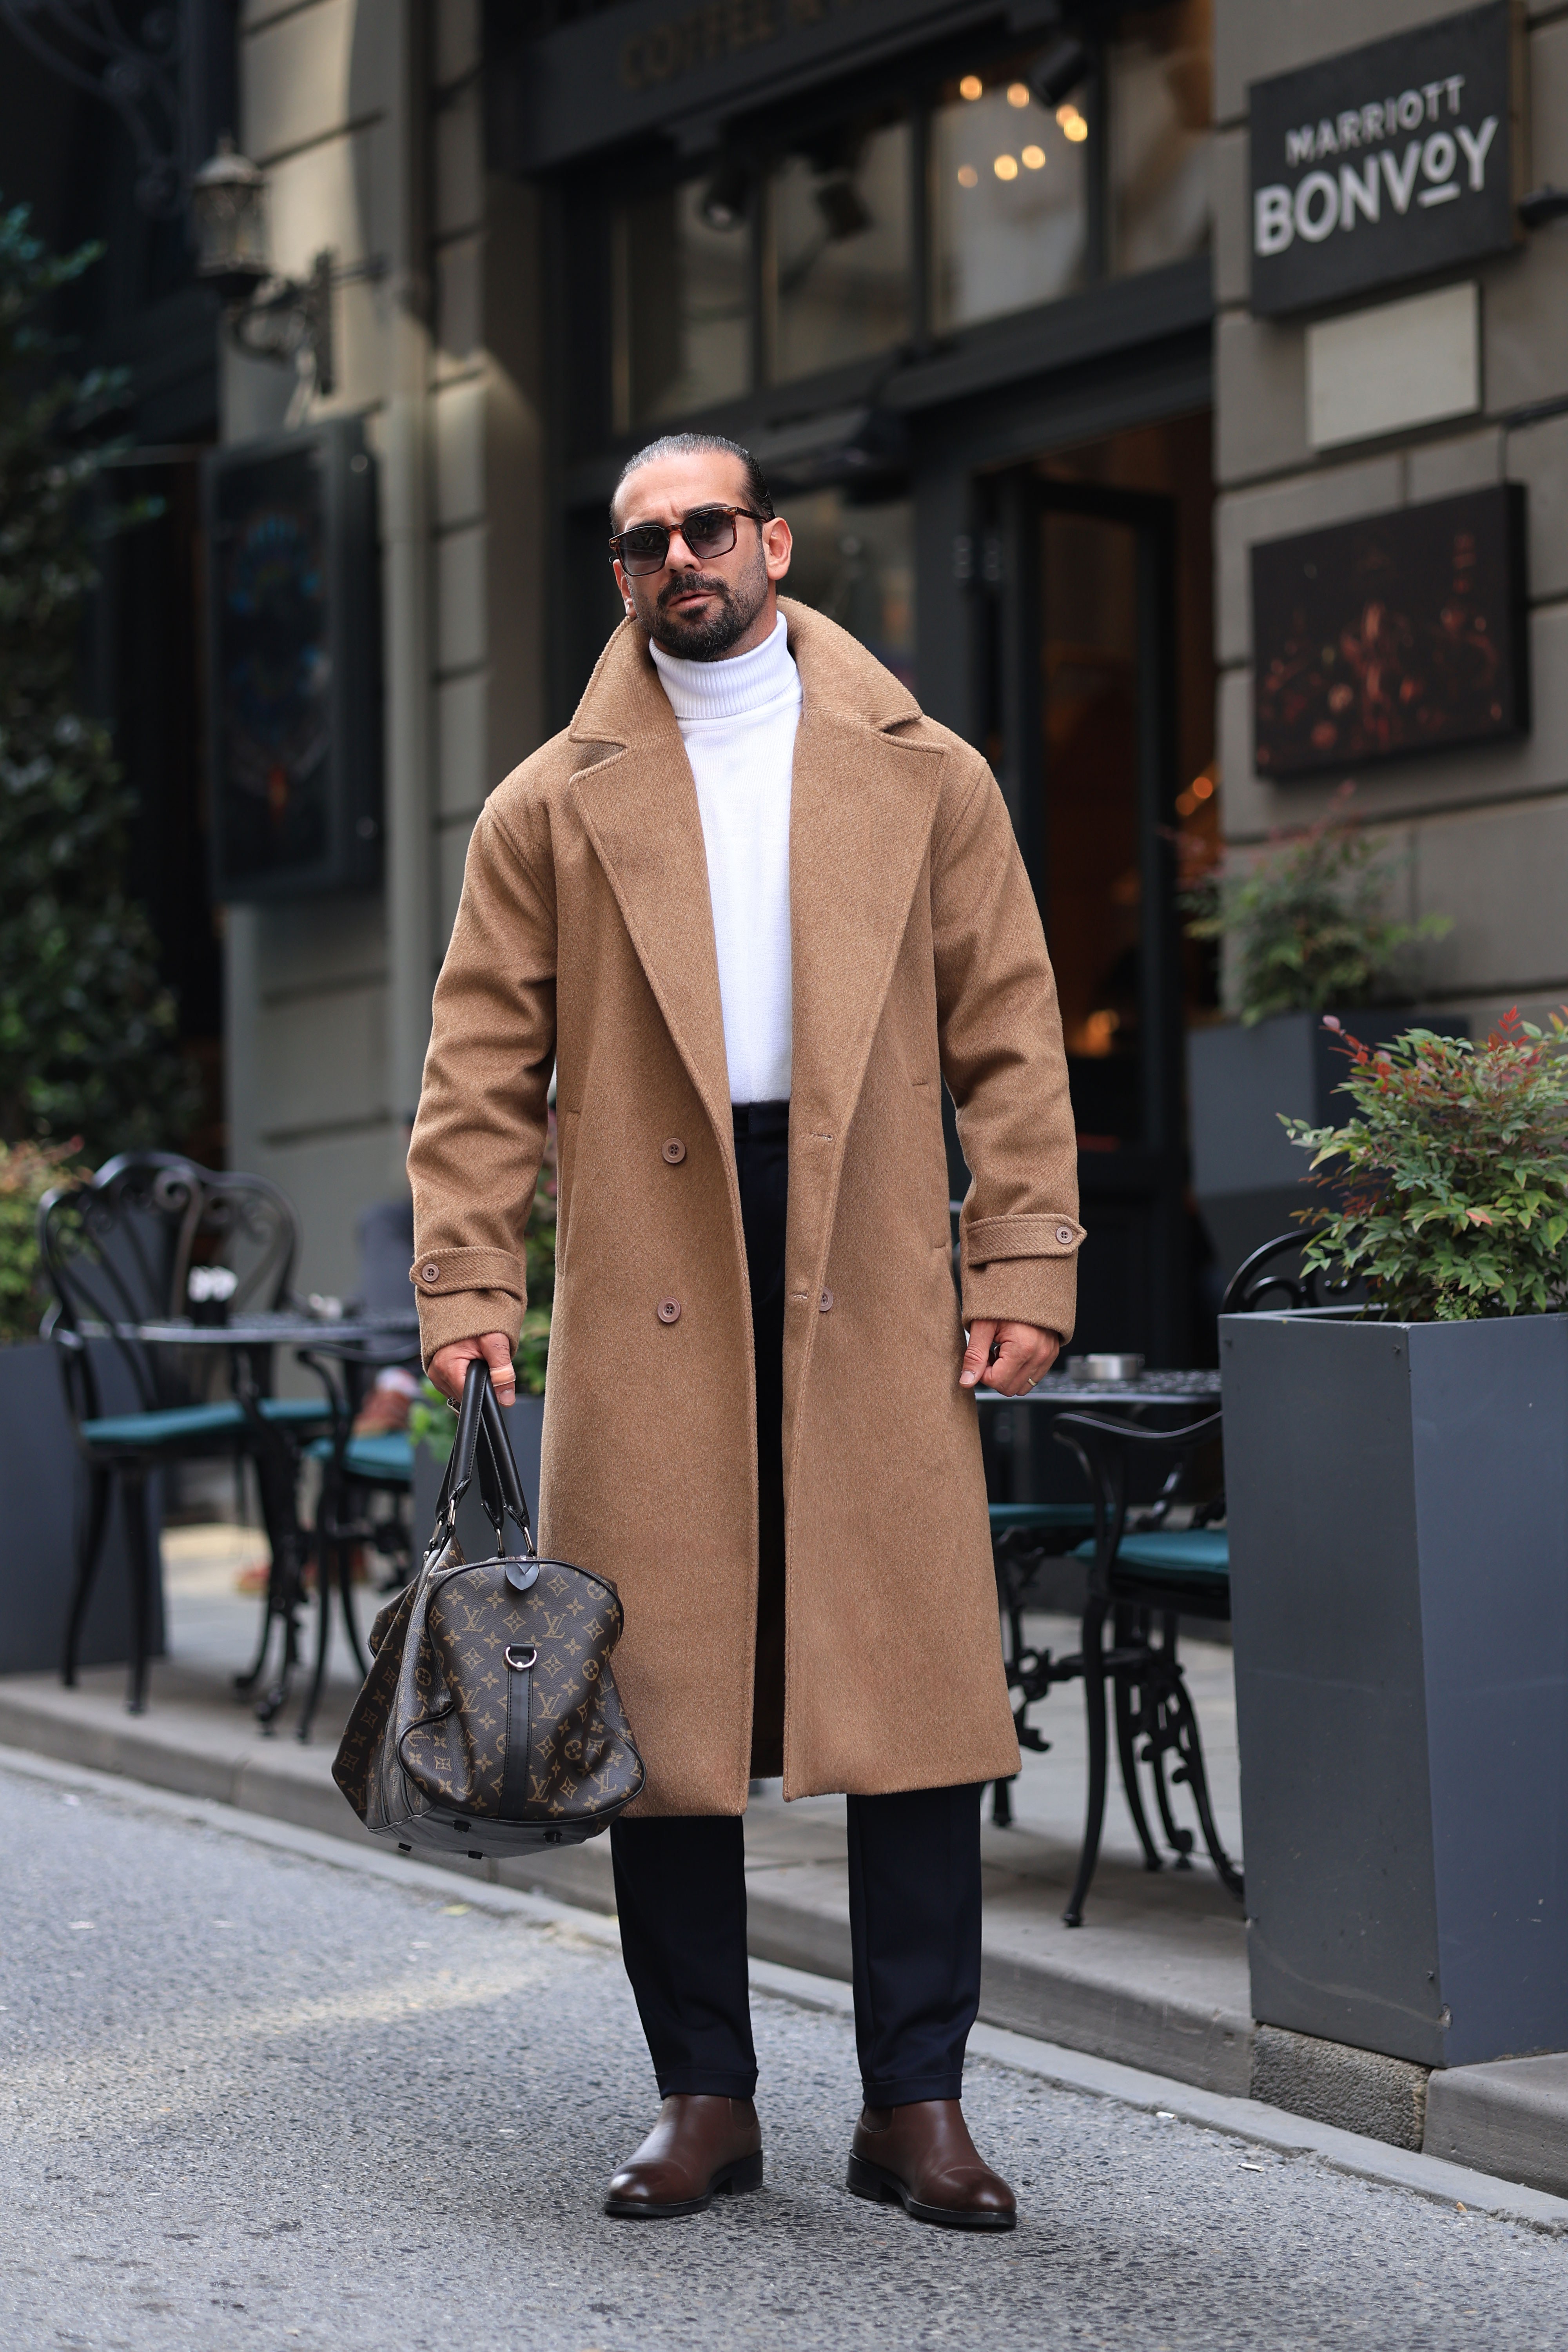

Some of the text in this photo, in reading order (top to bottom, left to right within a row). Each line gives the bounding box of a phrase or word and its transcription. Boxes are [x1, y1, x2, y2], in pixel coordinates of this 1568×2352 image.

[1286, 75, 1465, 166] MARRIOTT
[1254, 116, 1498, 257] BONVOY
[462, 1606, 487, 1632] LV
[542, 1612, 567, 1639] LV
[537, 1692, 562, 1719] LV
[527, 1775, 552, 1802] LV
